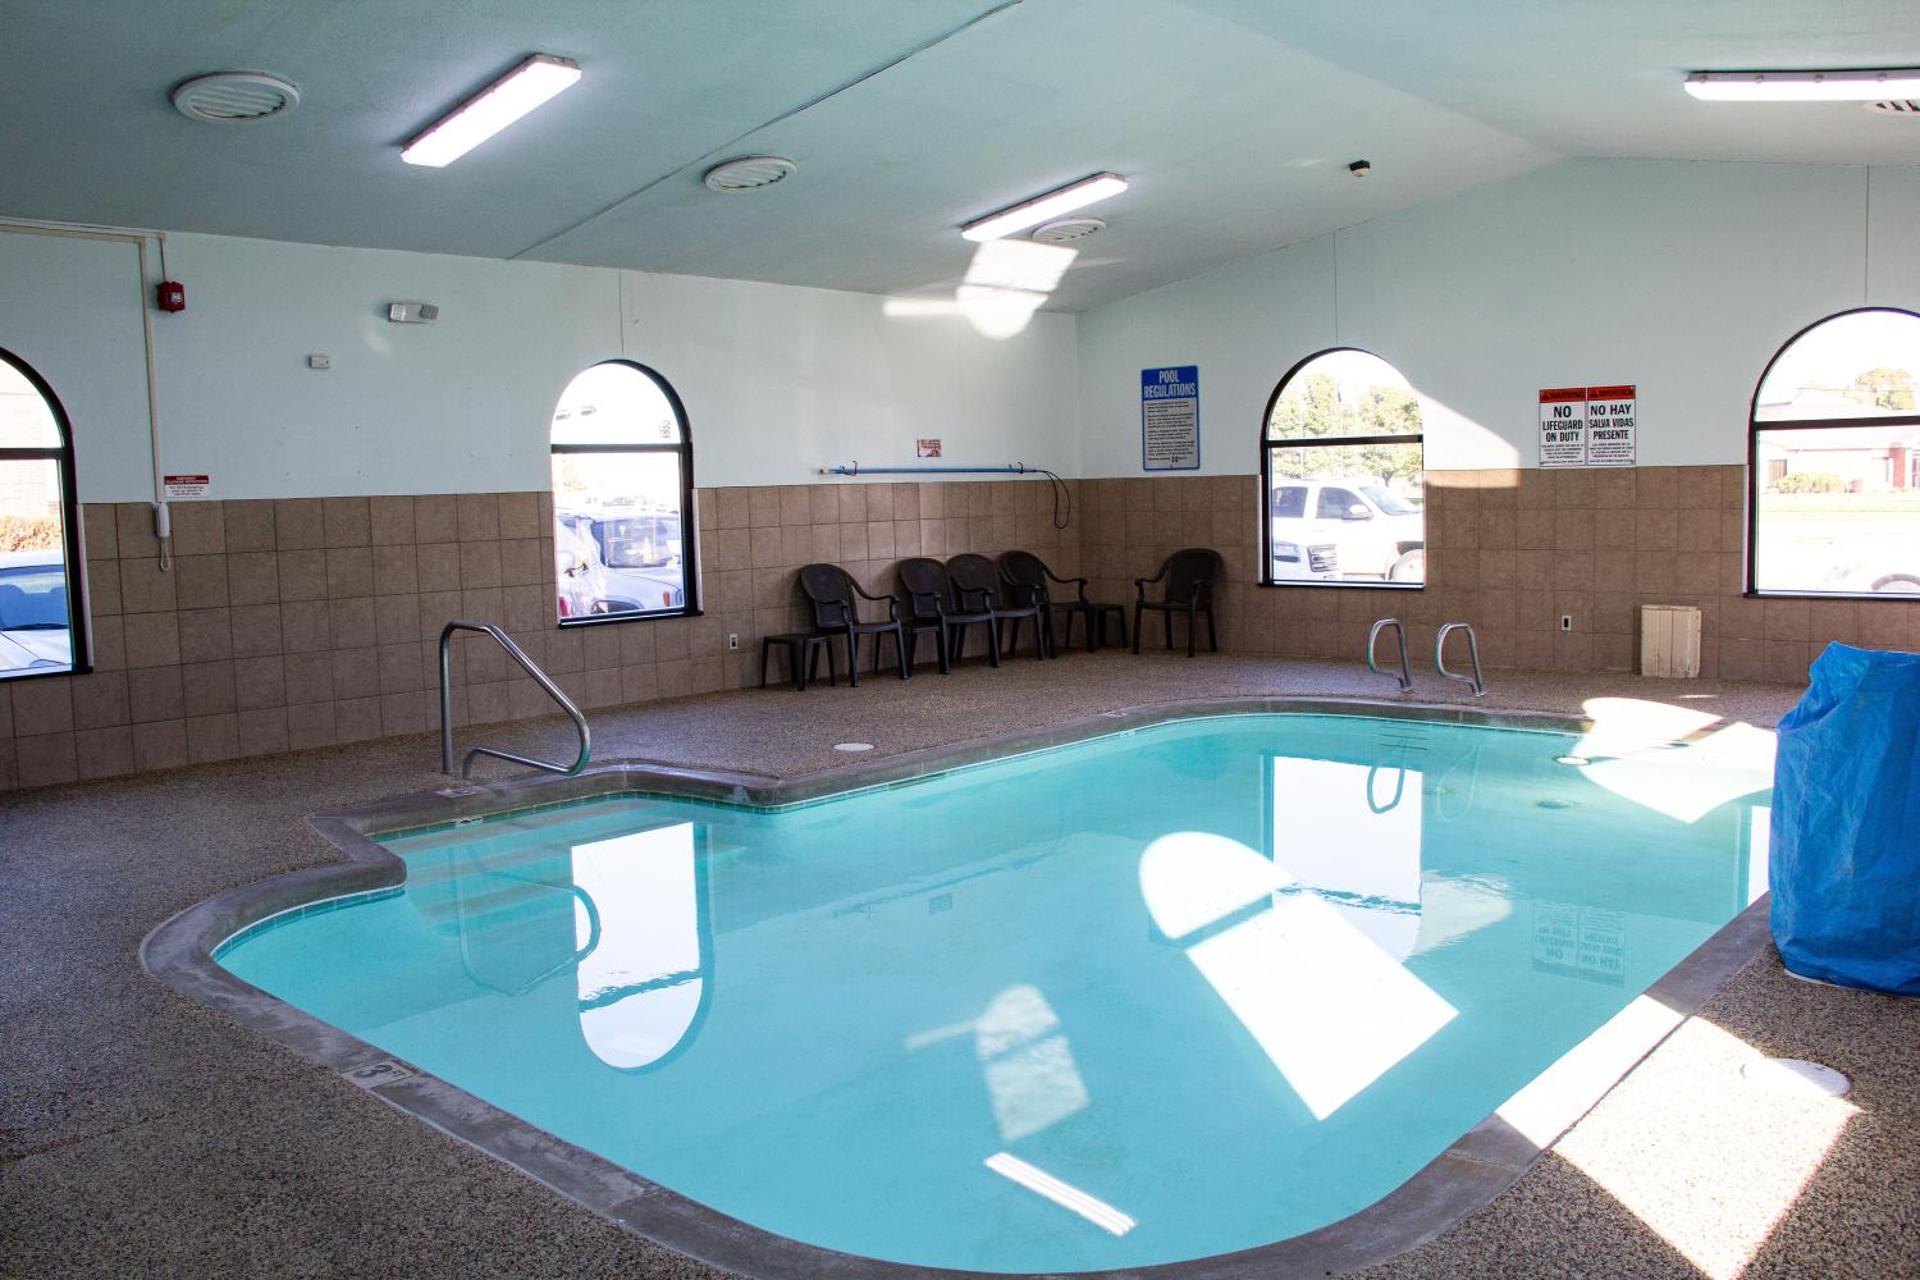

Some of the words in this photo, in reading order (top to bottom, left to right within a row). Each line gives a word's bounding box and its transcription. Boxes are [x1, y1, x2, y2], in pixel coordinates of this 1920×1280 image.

[1158, 370, 1180, 383] POOL
[1144, 383, 1196, 398] REGULATIONS
[1553, 405, 1572, 418] NO
[1590, 405, 1606, 416] NO
[1609, 403, 1632, 415] HAY
[1542, 419, 1583, 431] LIFEGUARD
[1589, 418, 1611, 429] SALVA
[1612, 417, 1634, 428] VIDAS
[1546, 432, 1557, 443] ON
[1559, 431, 1580, 442] DUTY
[1593, 429, 1629, 441] PRESENTE
